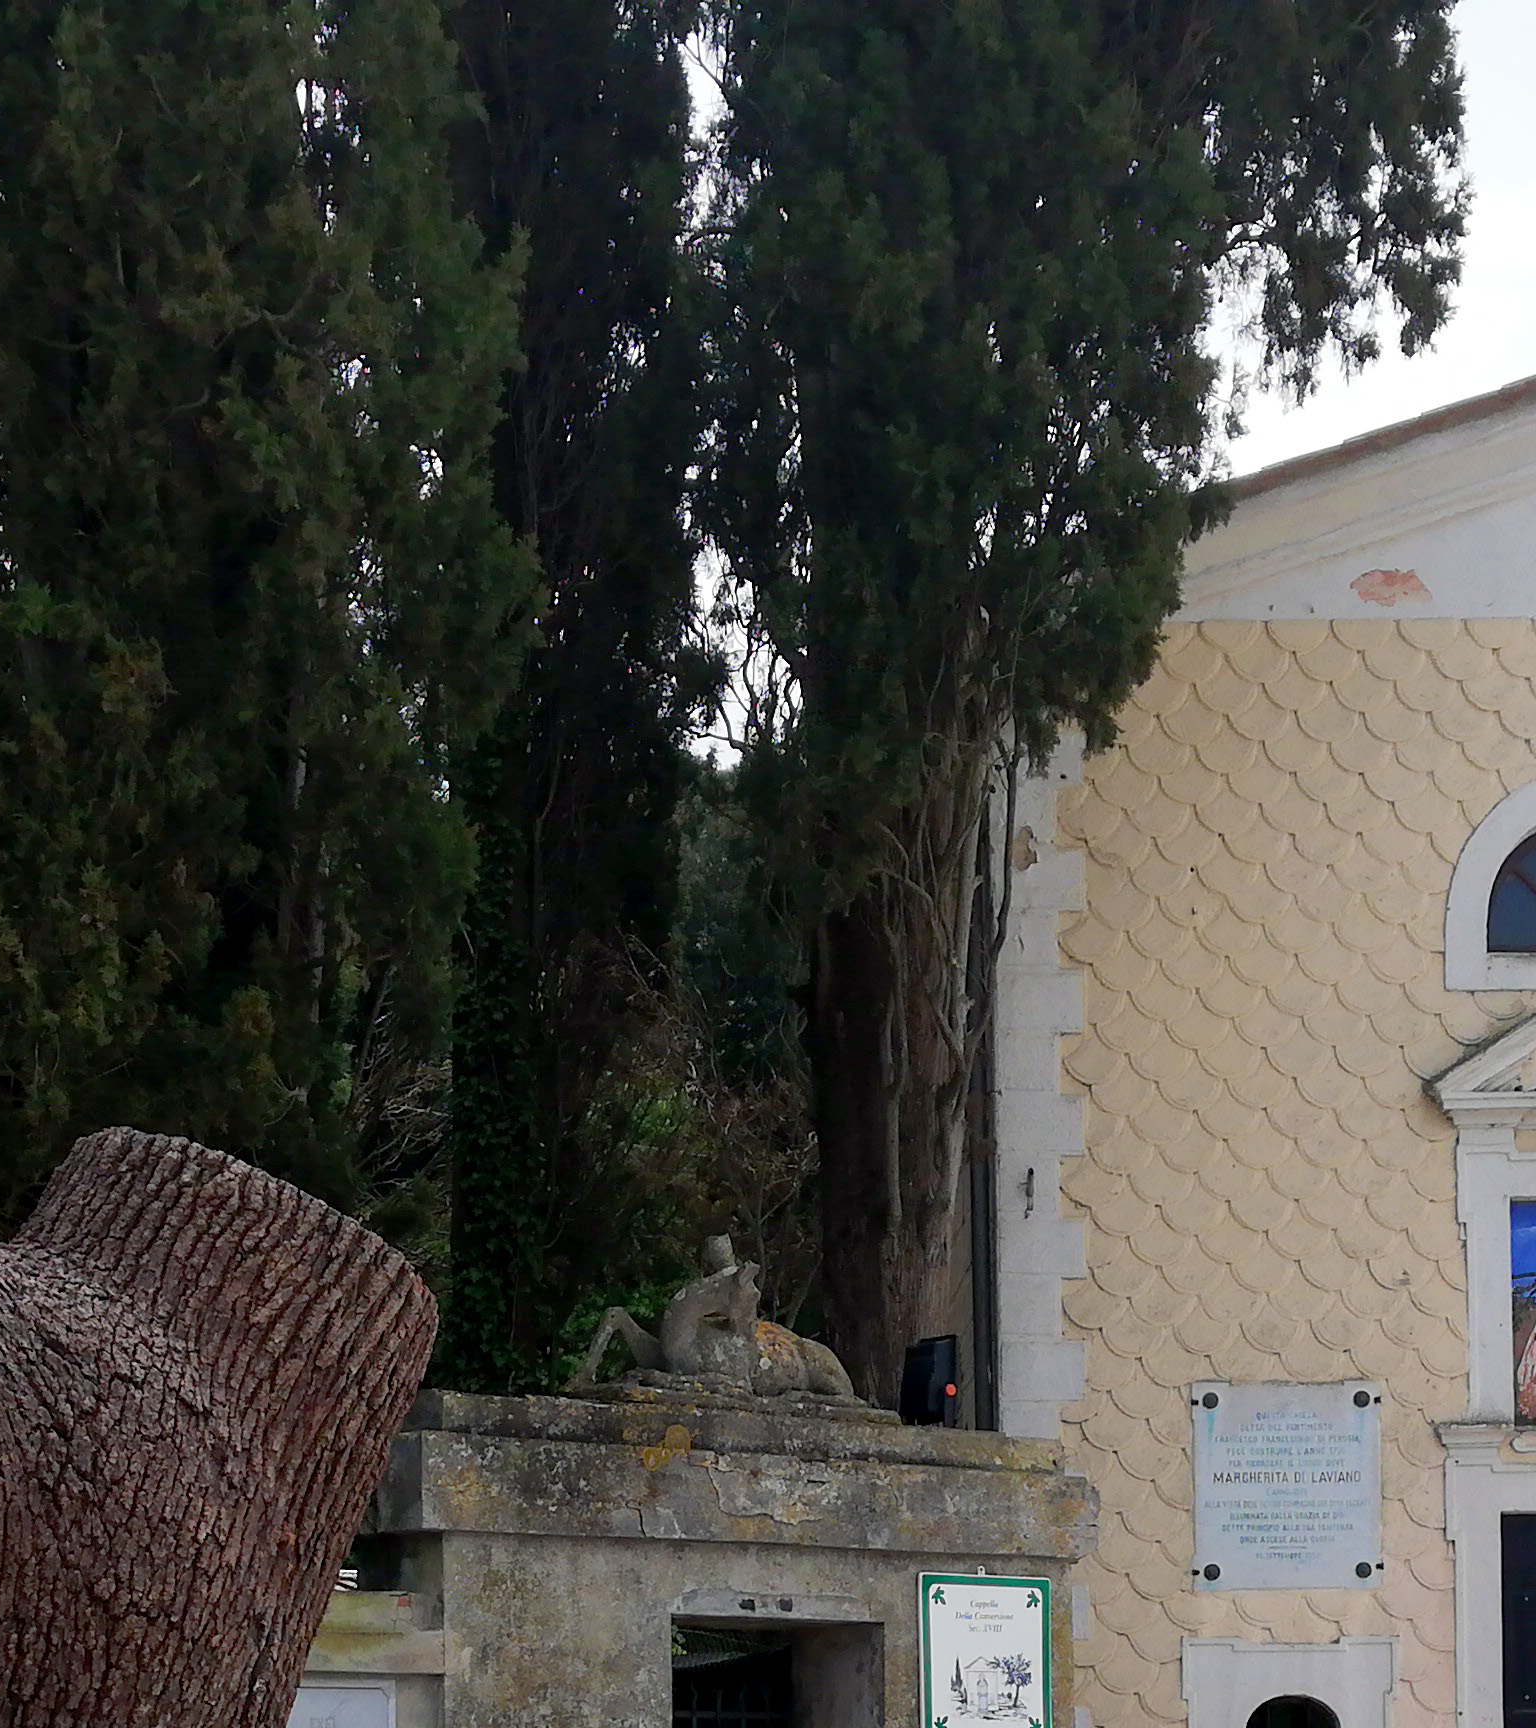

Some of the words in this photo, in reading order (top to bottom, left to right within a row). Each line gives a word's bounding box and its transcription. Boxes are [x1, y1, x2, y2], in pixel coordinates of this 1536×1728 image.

[1213, 1471, 1289, 1483] MARGHERITA
[1294, 1471, 1305, 1483] DI
[1312, 1471, 1361, 1483] LAVIANO
[970, 1600, 998, 1609] Cappella
